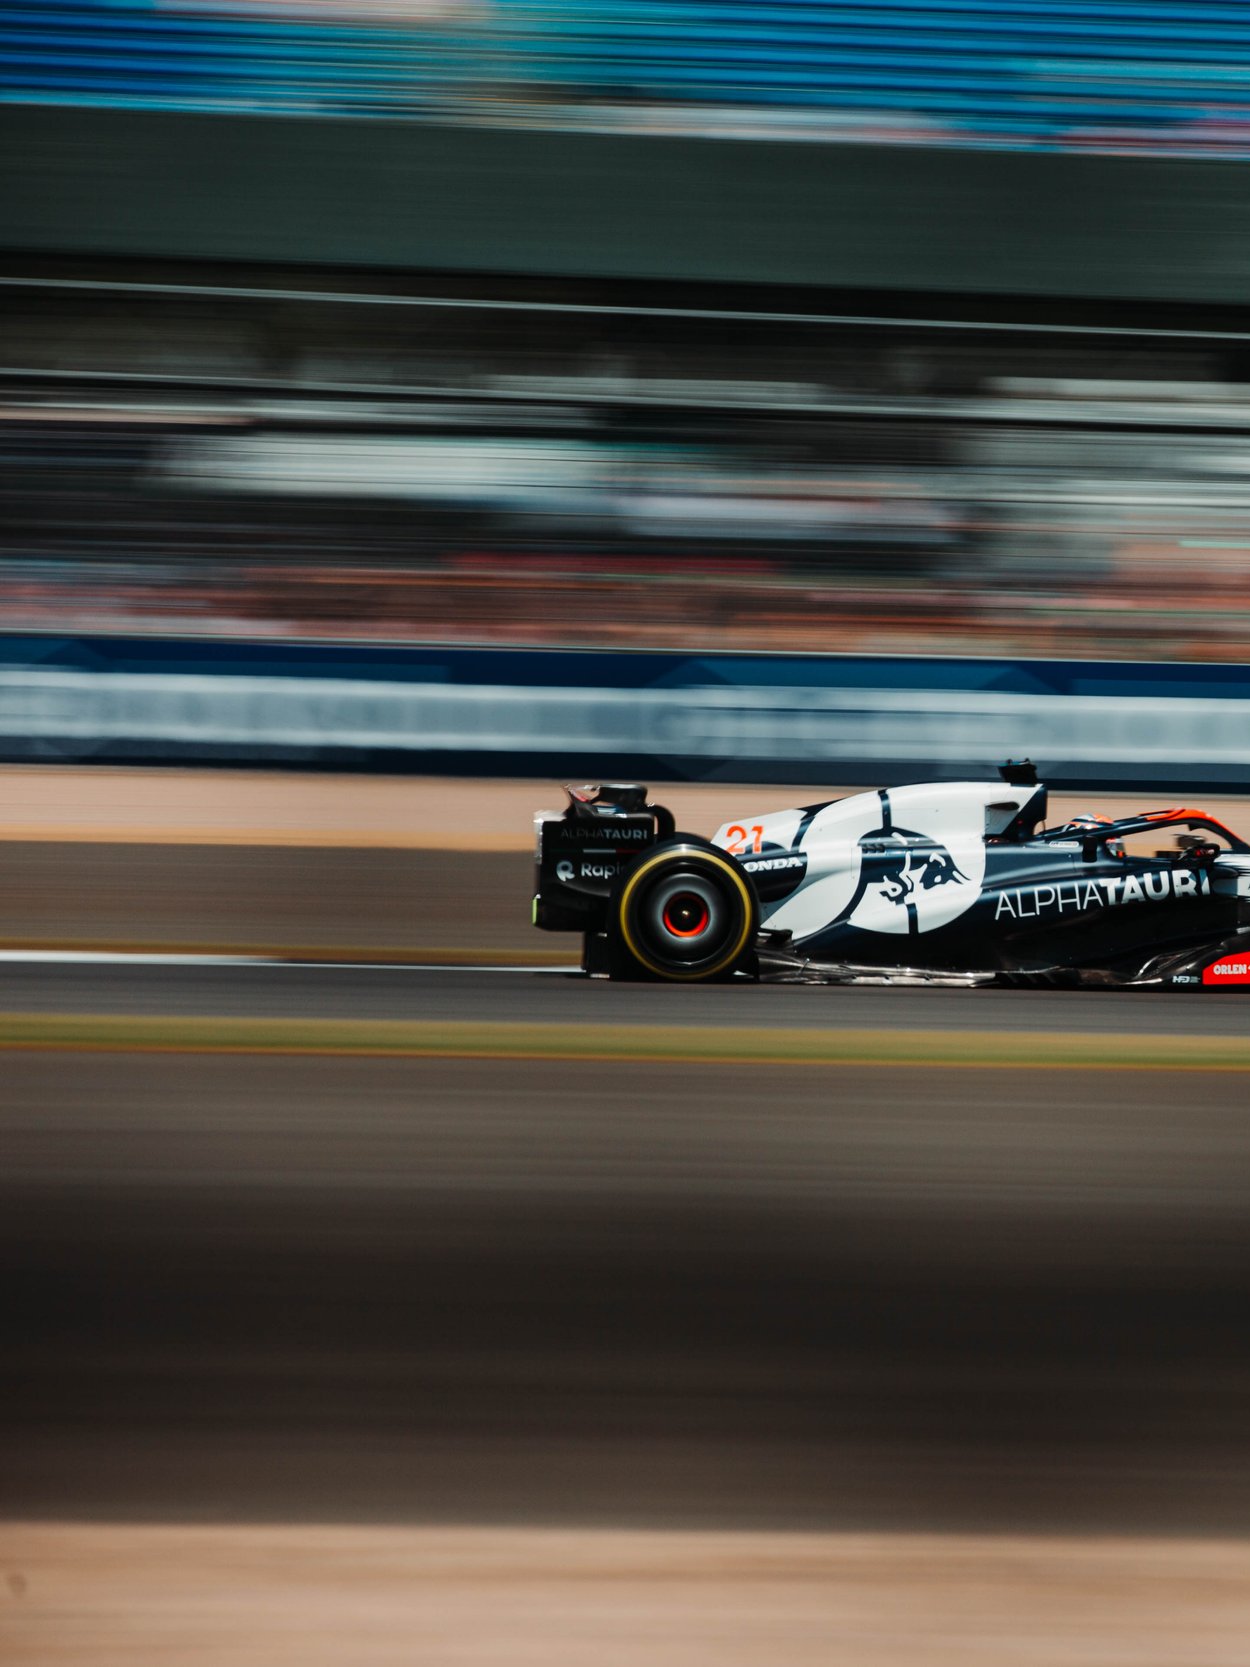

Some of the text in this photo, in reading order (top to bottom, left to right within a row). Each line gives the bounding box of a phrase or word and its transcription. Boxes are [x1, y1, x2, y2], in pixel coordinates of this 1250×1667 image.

[560, 828, 648, 839] ALPHATAURI
[726, 825, 763, 852] 21
[741, 857, 803, 873] ONDA
[994, 869, 1211, 920] ALPHATAURI
[1213, 964, 1247, 975] ORLEN
